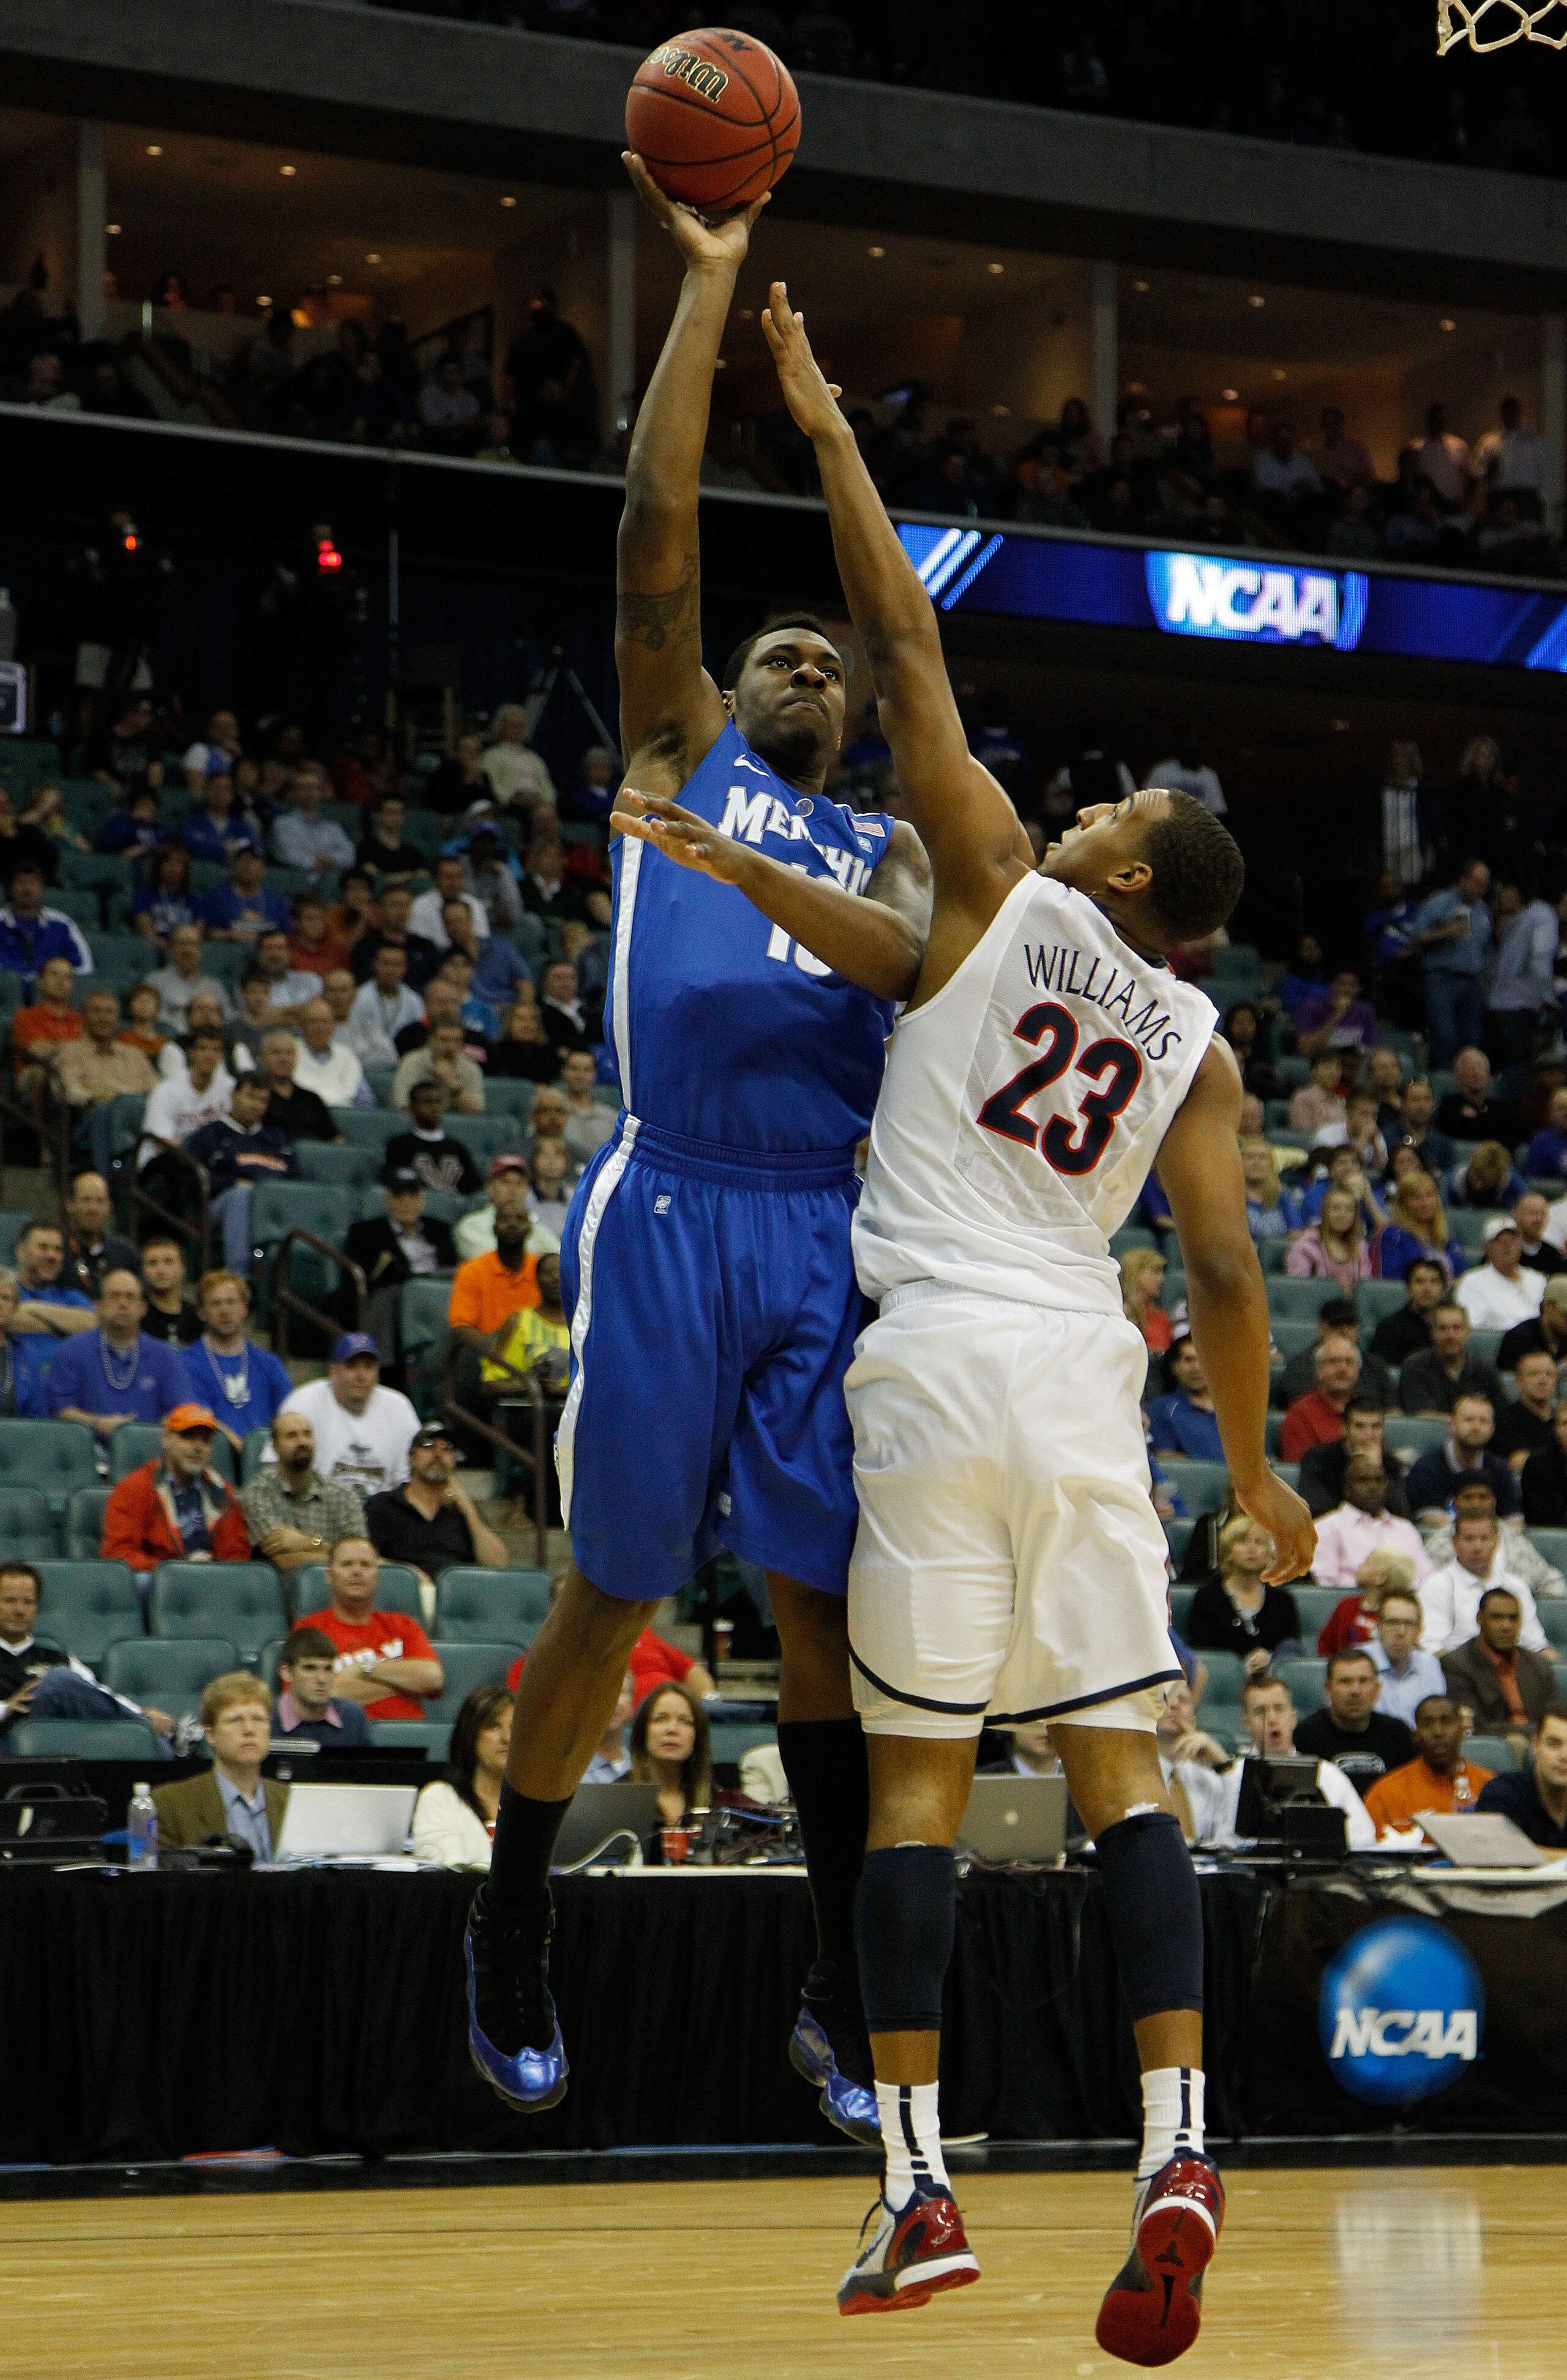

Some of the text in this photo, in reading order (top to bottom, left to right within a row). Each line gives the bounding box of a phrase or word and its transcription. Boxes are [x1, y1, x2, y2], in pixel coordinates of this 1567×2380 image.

[645, 46, 729, 104] Wilso
[1167, 553, 1339, 643] NCAA
[1024, 944, 1182, 1061] WILLIAMS
[976, 1002, 1143, 1176] 23
[1330, 2006, 1478, 2061] NCAA
